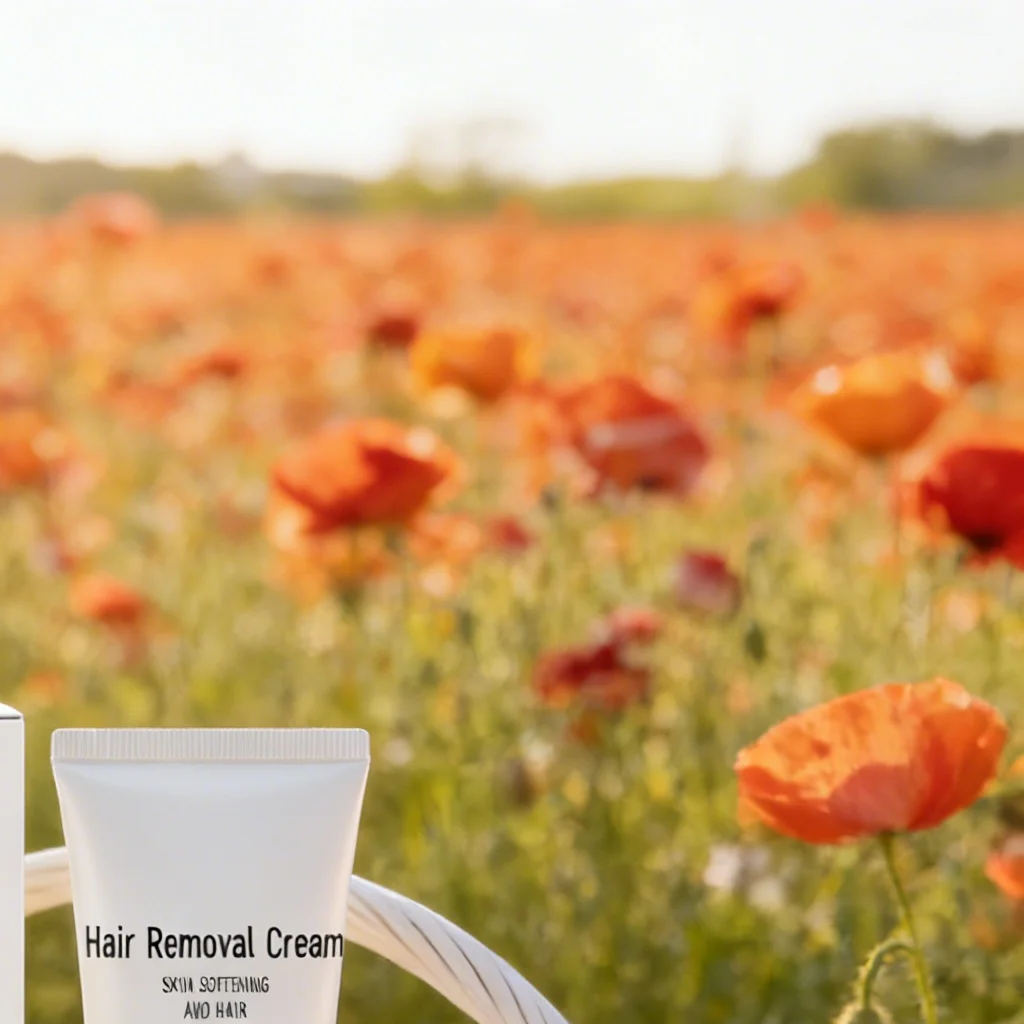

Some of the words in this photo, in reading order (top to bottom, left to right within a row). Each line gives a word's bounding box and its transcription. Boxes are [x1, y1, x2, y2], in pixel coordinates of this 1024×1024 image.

[85, 925, 136, 959] Hair
[147, 925, 255, 960] Removal
[266, 926, 344, 959] Cream
